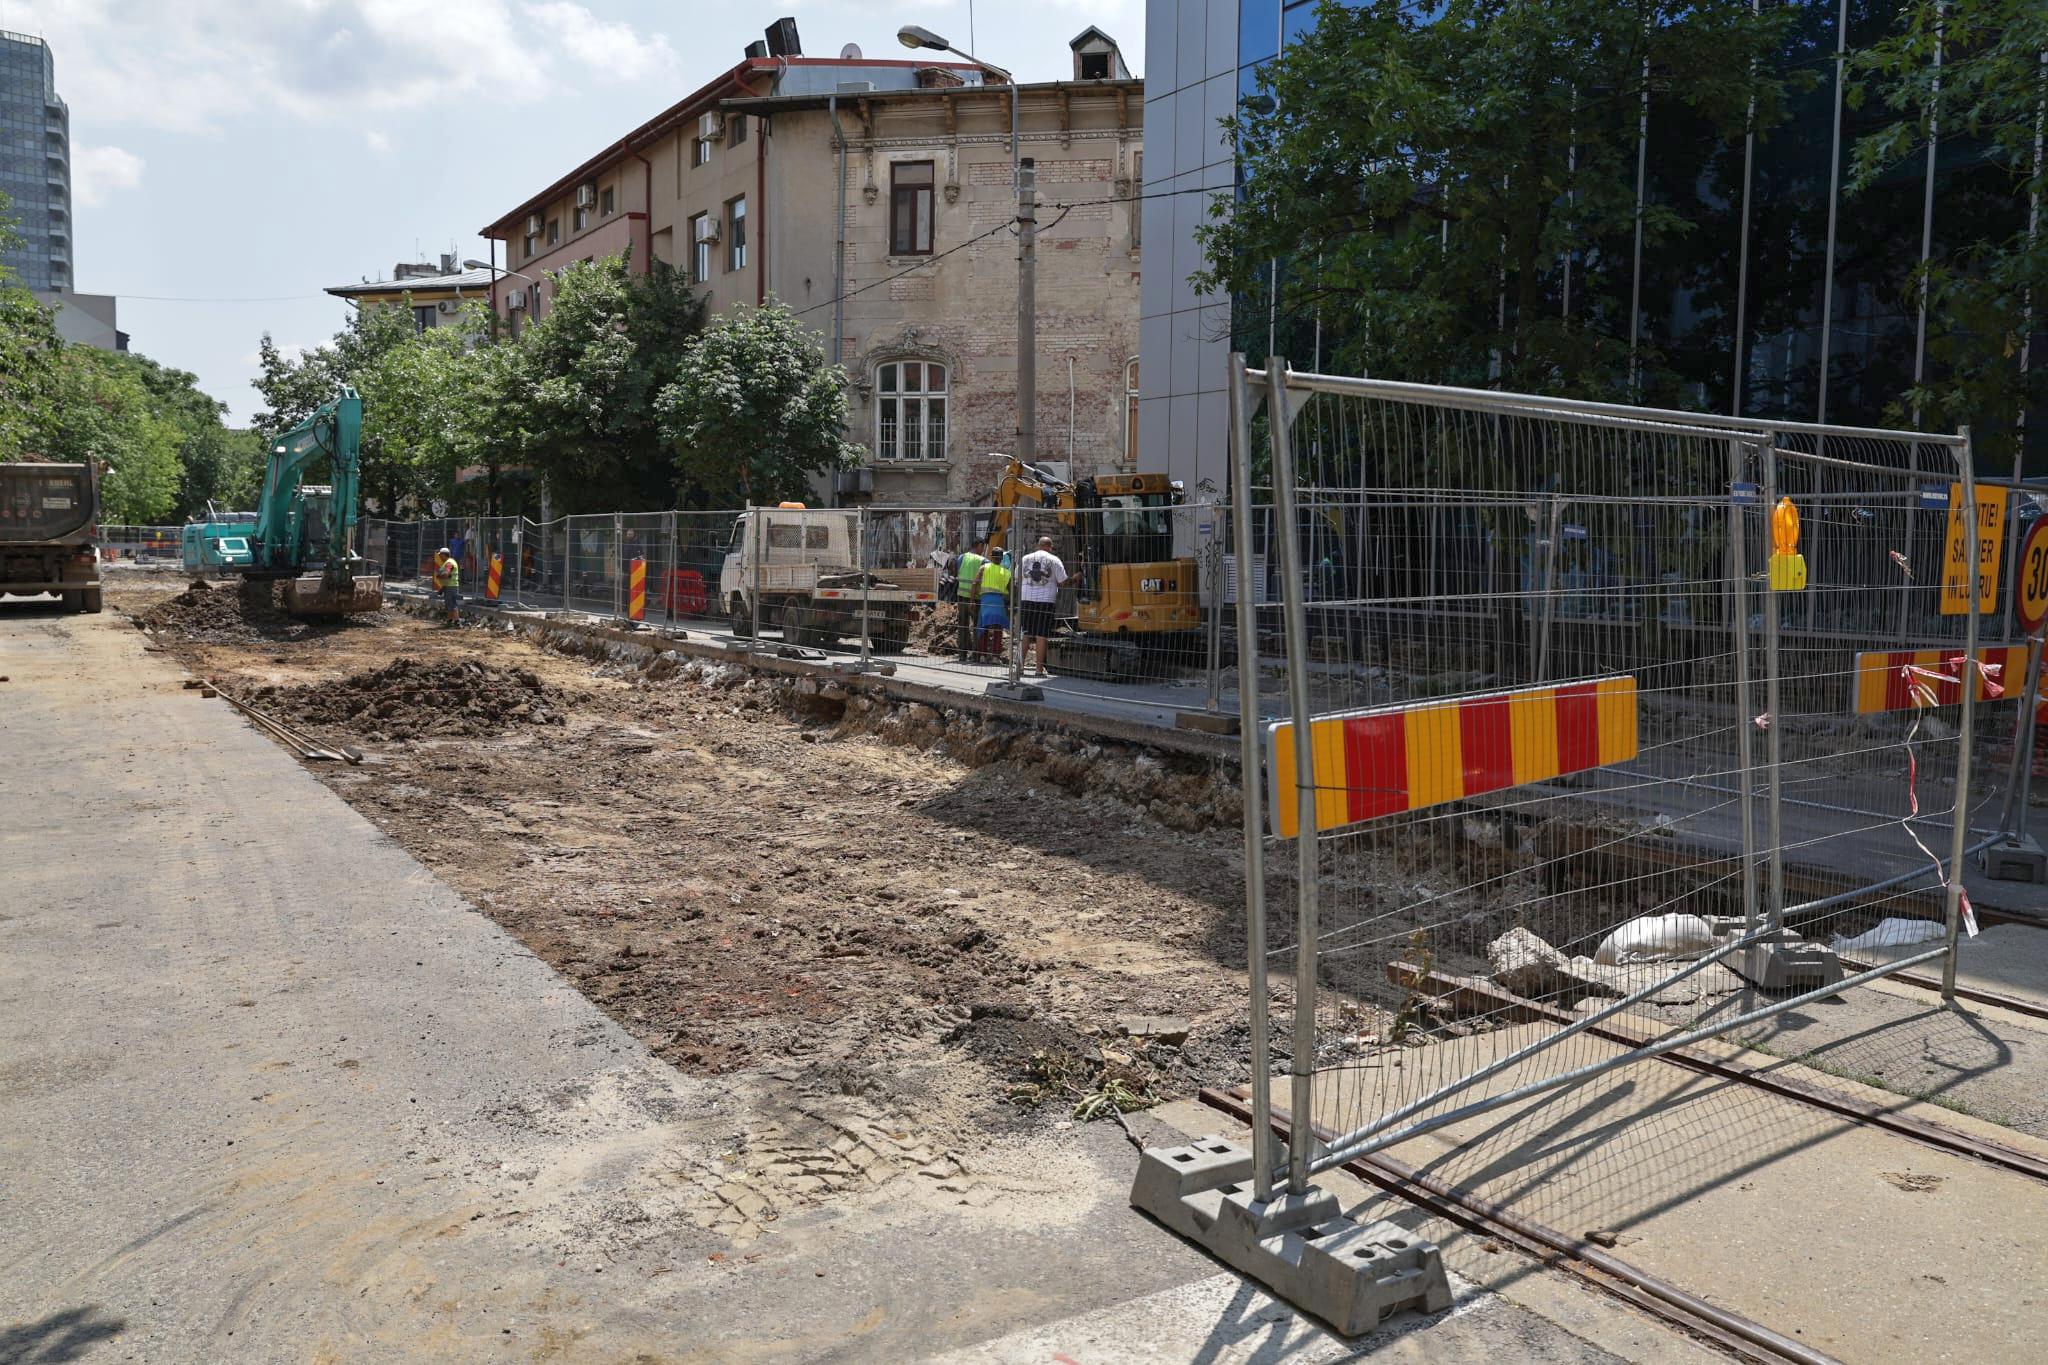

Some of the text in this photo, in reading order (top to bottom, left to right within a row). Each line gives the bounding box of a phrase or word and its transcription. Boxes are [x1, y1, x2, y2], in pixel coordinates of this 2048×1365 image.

[1141, 578, 1162, 593] CAT
[2027, 546, 2048, 602] 30
[1947, 575, 1992, 600] IN LURU
